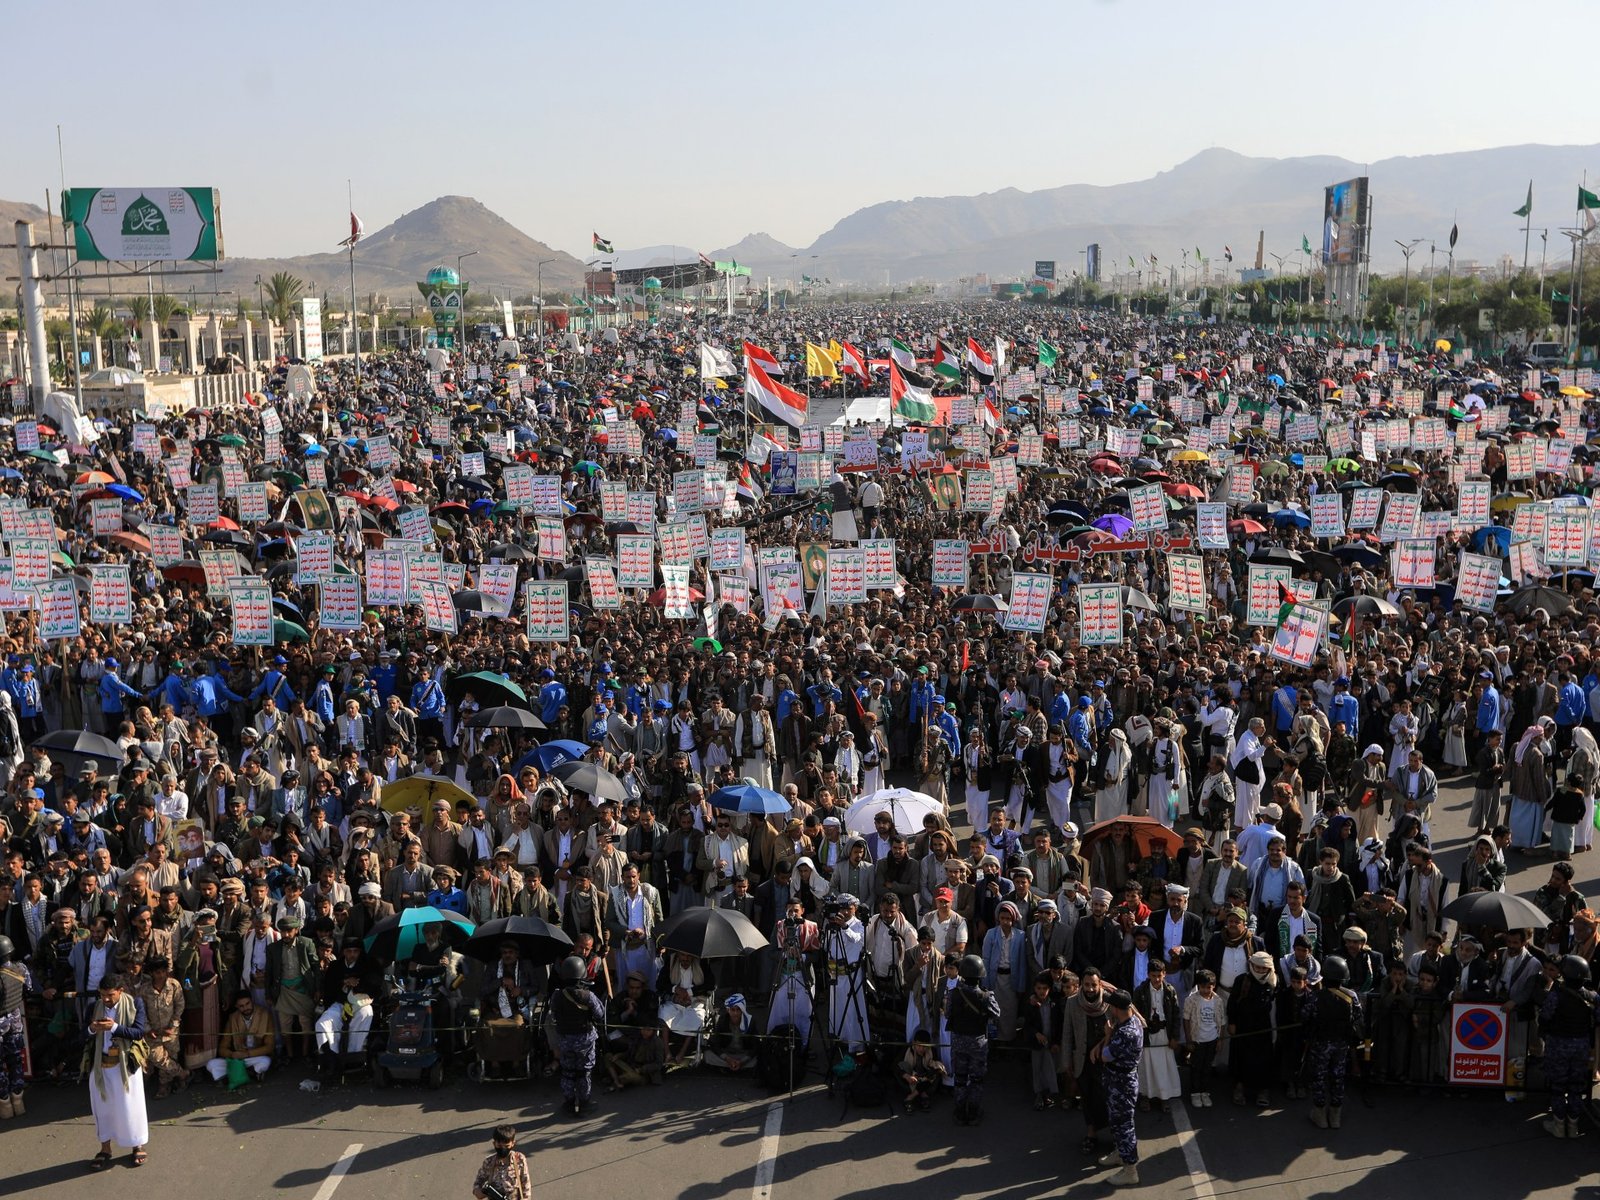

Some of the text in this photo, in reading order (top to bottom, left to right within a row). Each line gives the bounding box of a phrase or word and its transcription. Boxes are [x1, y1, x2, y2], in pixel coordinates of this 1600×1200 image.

[1086, 531, 1149, 558] تنتصر
[1153, 528, 1191, 554] غزة
[1023, 539, 1080, 563] طوفان
[112, 570, 126, 578] الله
[1104, 590, 1117, 598] الله
[1483, 1067, 1497, 1077] أمام
